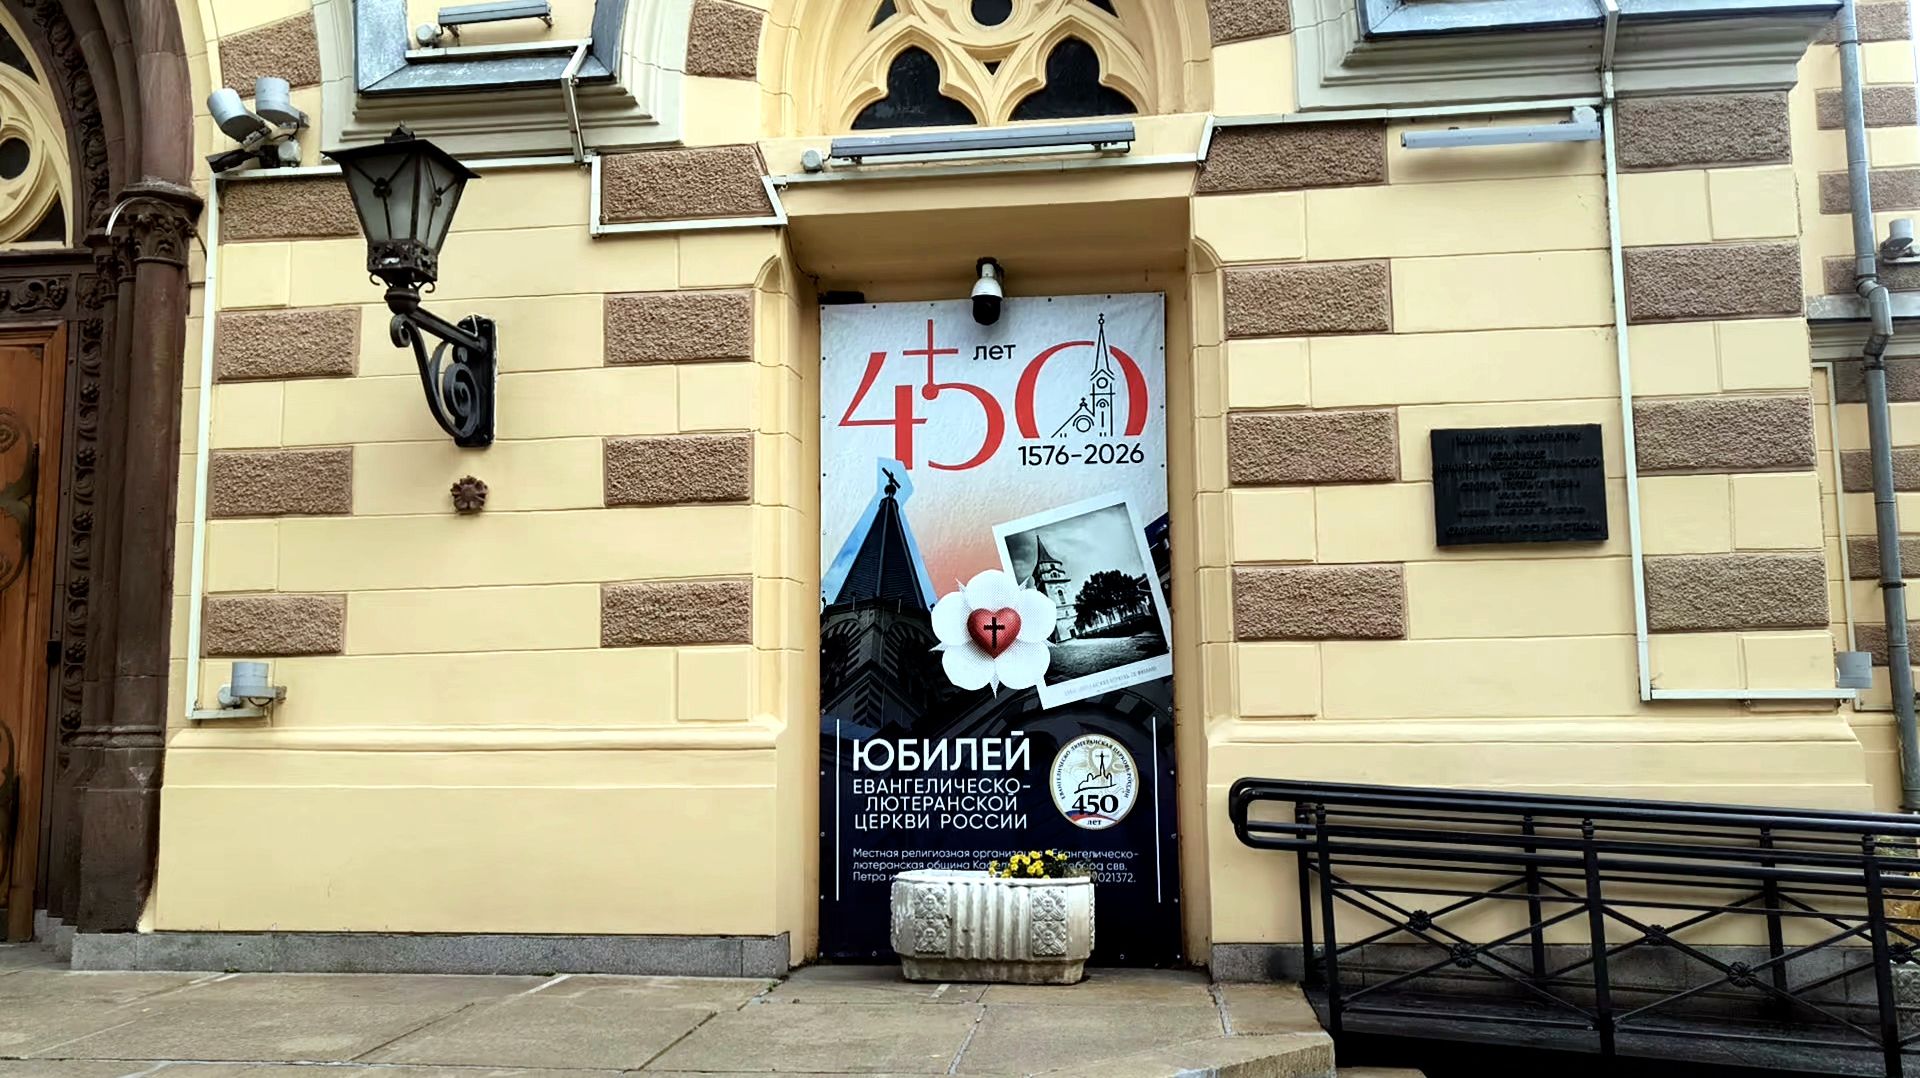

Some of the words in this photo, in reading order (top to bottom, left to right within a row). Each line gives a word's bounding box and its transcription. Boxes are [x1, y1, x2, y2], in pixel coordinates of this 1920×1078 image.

[972, 344, 1016, 361] лет
[852, 730, 1030, 771] ЮБИЛЕЙ
[853, 778, 1031, 794] ЕВАНГЕЛИЧЕСКО-
[865, 792, 1017, 811] ЛЮТЕРАНСКОЙ
[1071, 794, 1119, 815] 450
[855, 814, 930, 831] ЦЕРКВИ
[940, 814, 1027, 829] РОССИИ
[853, 848, 899, 858] Местная
[901, 849, 970, 860] религиозная
[853, 861, 924, 871] лютеранская
[926, 861, 970, 871] община
[853, 871, 886, 883] Петра
